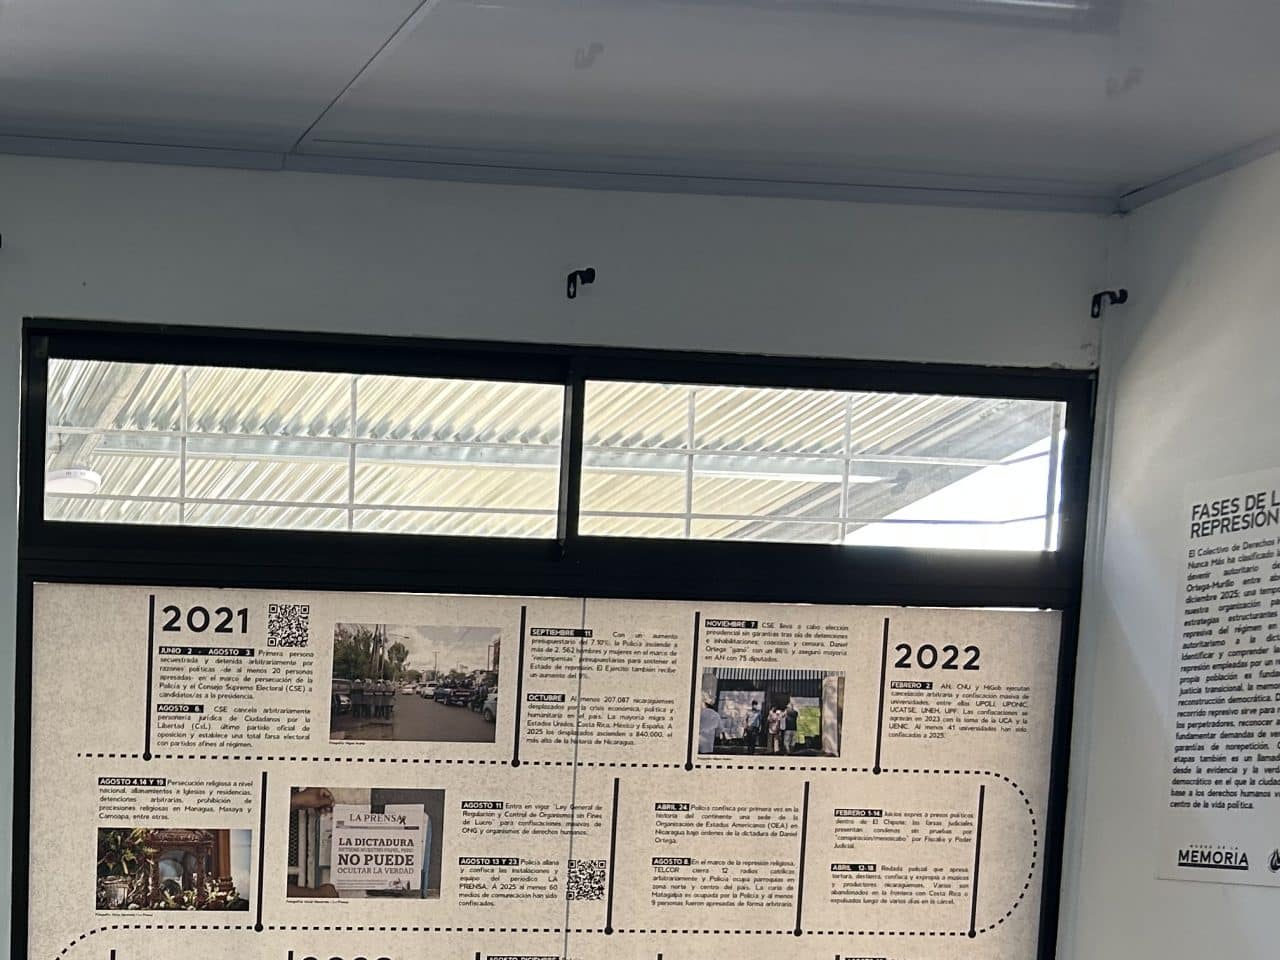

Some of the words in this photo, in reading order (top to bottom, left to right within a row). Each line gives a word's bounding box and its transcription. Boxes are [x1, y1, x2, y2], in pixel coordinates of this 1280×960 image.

[1192, 498, 1240, 521] FASES
[1245, 492, 1267, 512] DE
[1190, 507, 1279, 538] REPRESIÓN
[162, 605, 248, 633] 2021
[894, 643, 981, 671] 2022
[350, 814, 361, 822] LA
[364, 814, 403, 822] PRENSA
[339, 838, 353, 846] LA
[355, 838, 414, 847] DICTADURA
[338, 854, 360, 865] NO
[364, 854, 414, 866] PUEDE
[1178, 849, 1249, 866] MEMORIA
